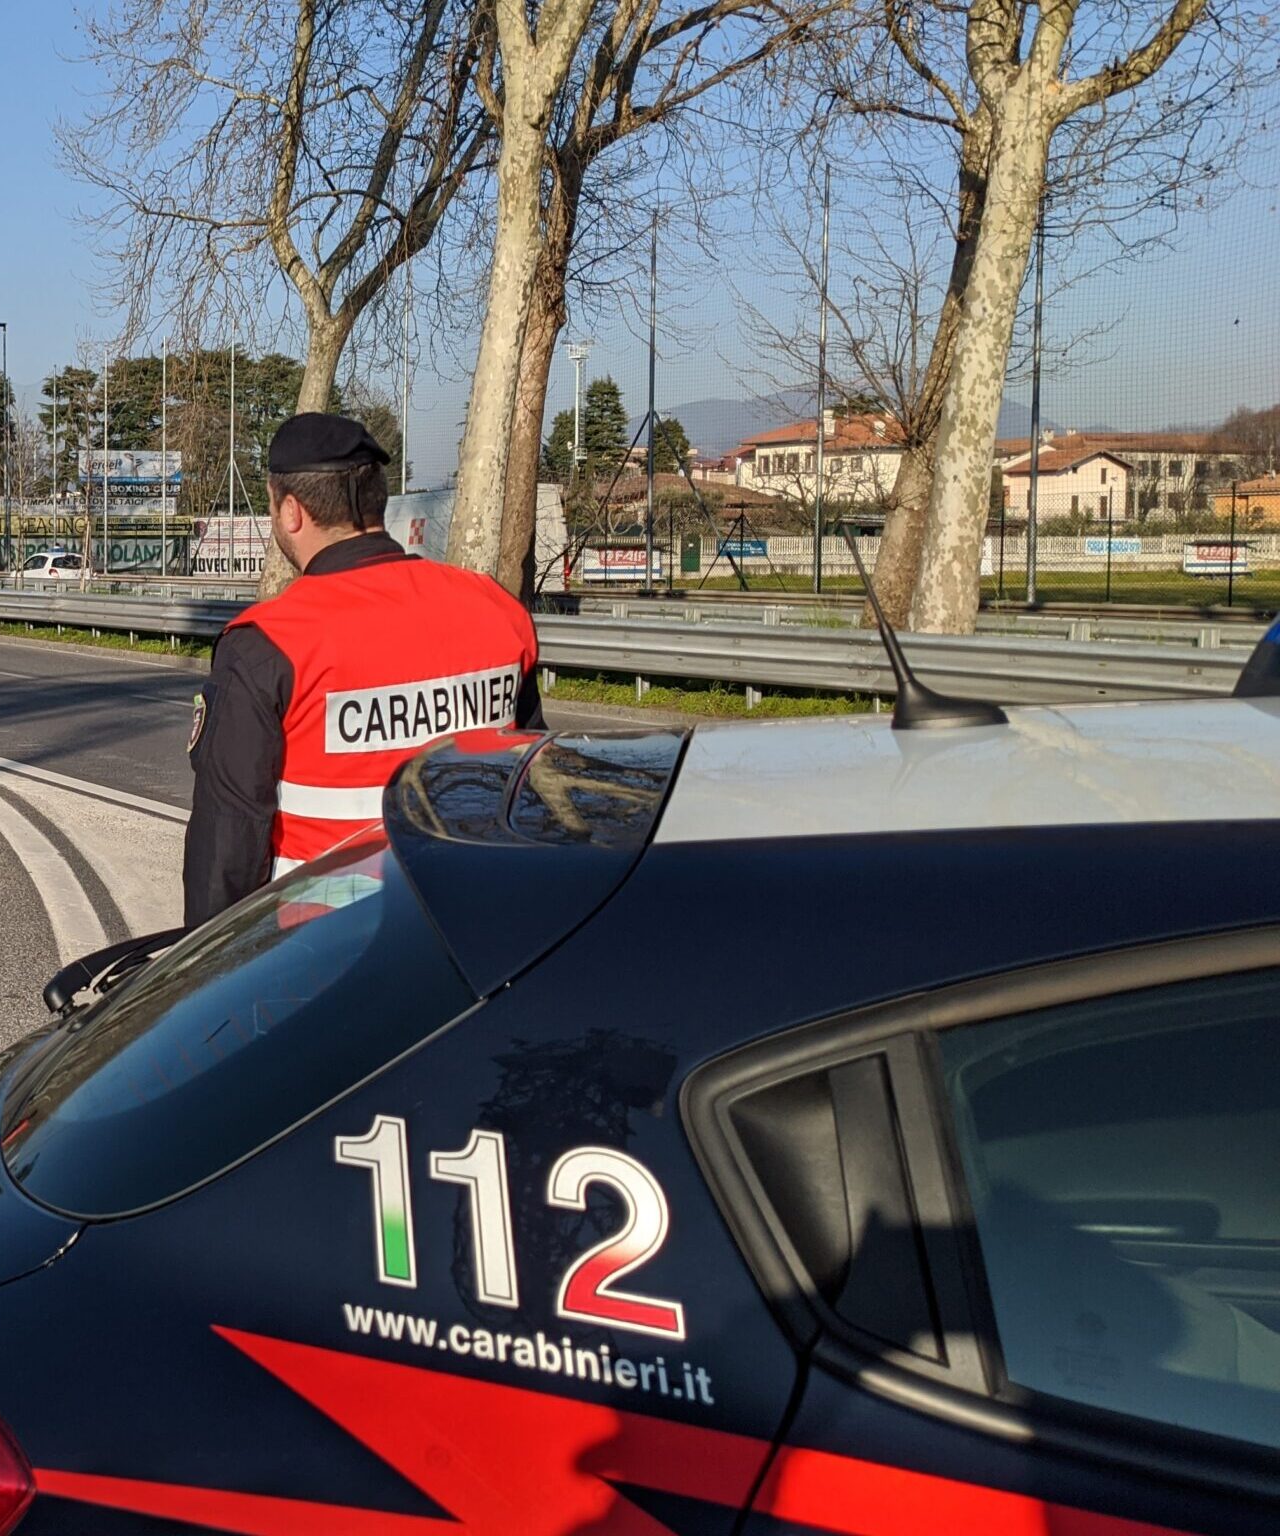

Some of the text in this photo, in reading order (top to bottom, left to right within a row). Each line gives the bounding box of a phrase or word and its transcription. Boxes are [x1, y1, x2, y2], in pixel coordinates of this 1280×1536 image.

[153, 485, 181, 493] CUB
[334, 1113, 686, 1342] 112
[343, 1302, 715, 1405] www.carabinieri.it
